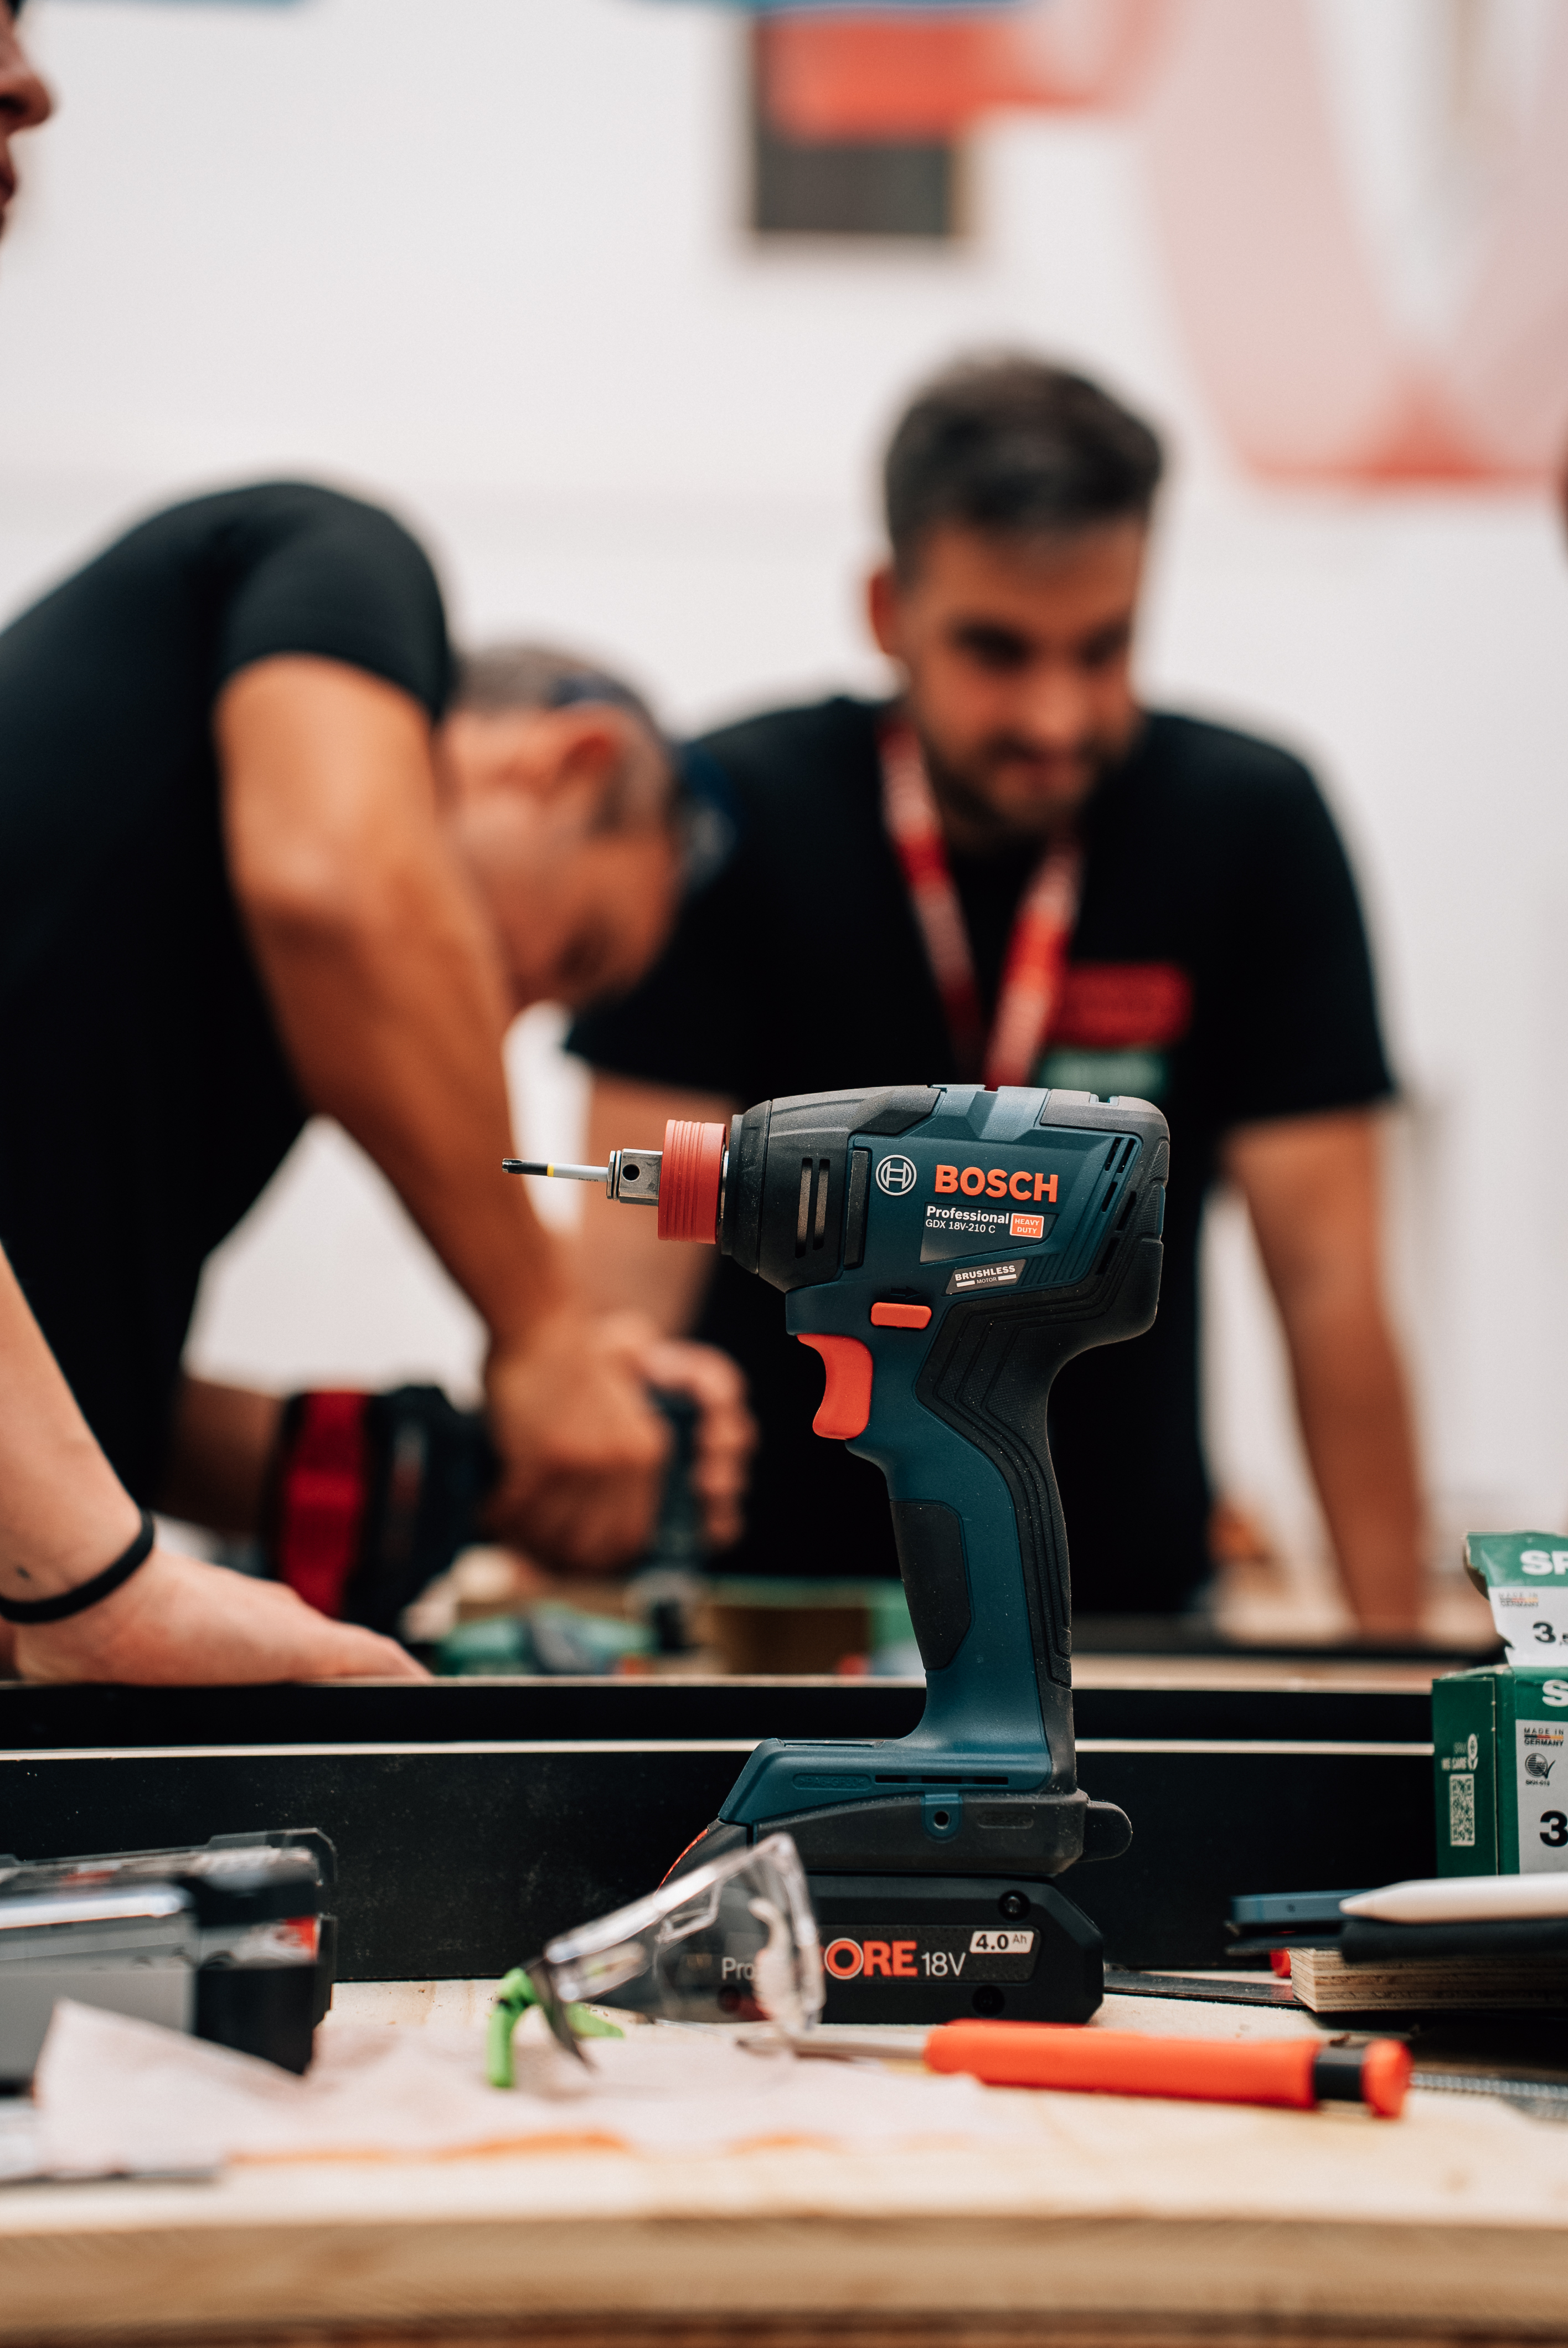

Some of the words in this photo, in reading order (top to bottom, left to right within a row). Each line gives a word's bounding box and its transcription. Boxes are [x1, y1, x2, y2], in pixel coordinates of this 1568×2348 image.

[935, 1165, 1058, 1202] BOSCH
[926, 1206, 1009, 1224] Professional
[1014, 1218, 1040, 1226] HEAVY
[925, 1219, 946, 1229] GDX
[948, 1221, 986, 1233] 18V-210
[988, 1225, 996, 1233] C
[1017, 1226, 1038, 1234] DUTY
[955, 1265, 1016, 1281] BRUSHLESS
[1524, 1738, 1564, 1747] GERMANY
[1540, 1810, 1568, 1847] 3
[975, 1934, 1009, 1950] 4.0
[1012, 1934, 1027, 1945] Ah
[821, 1938, 919, 1980] ORE
[921, 1951, 967, 1977] 18V
